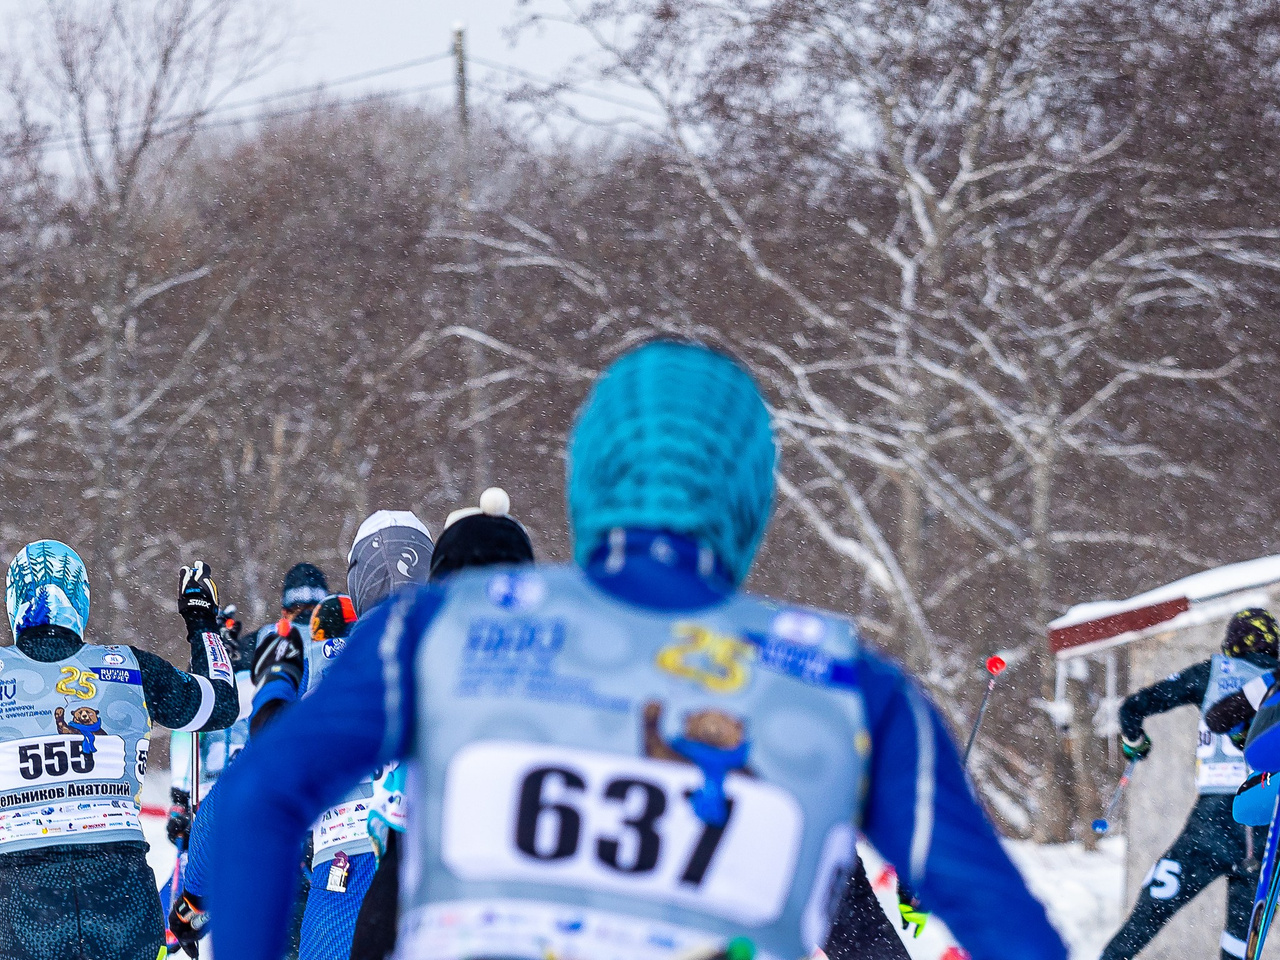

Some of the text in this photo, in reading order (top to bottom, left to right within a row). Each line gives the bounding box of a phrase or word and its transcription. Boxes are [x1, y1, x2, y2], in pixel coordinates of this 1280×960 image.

[187, 599, 211, 608] SWIX
[56, 667, 99, 700] 25
[18, 740, 95, 780] 555
[67, 781, 131, 798] Анатолий
[514, 765, 735, 889] 637
